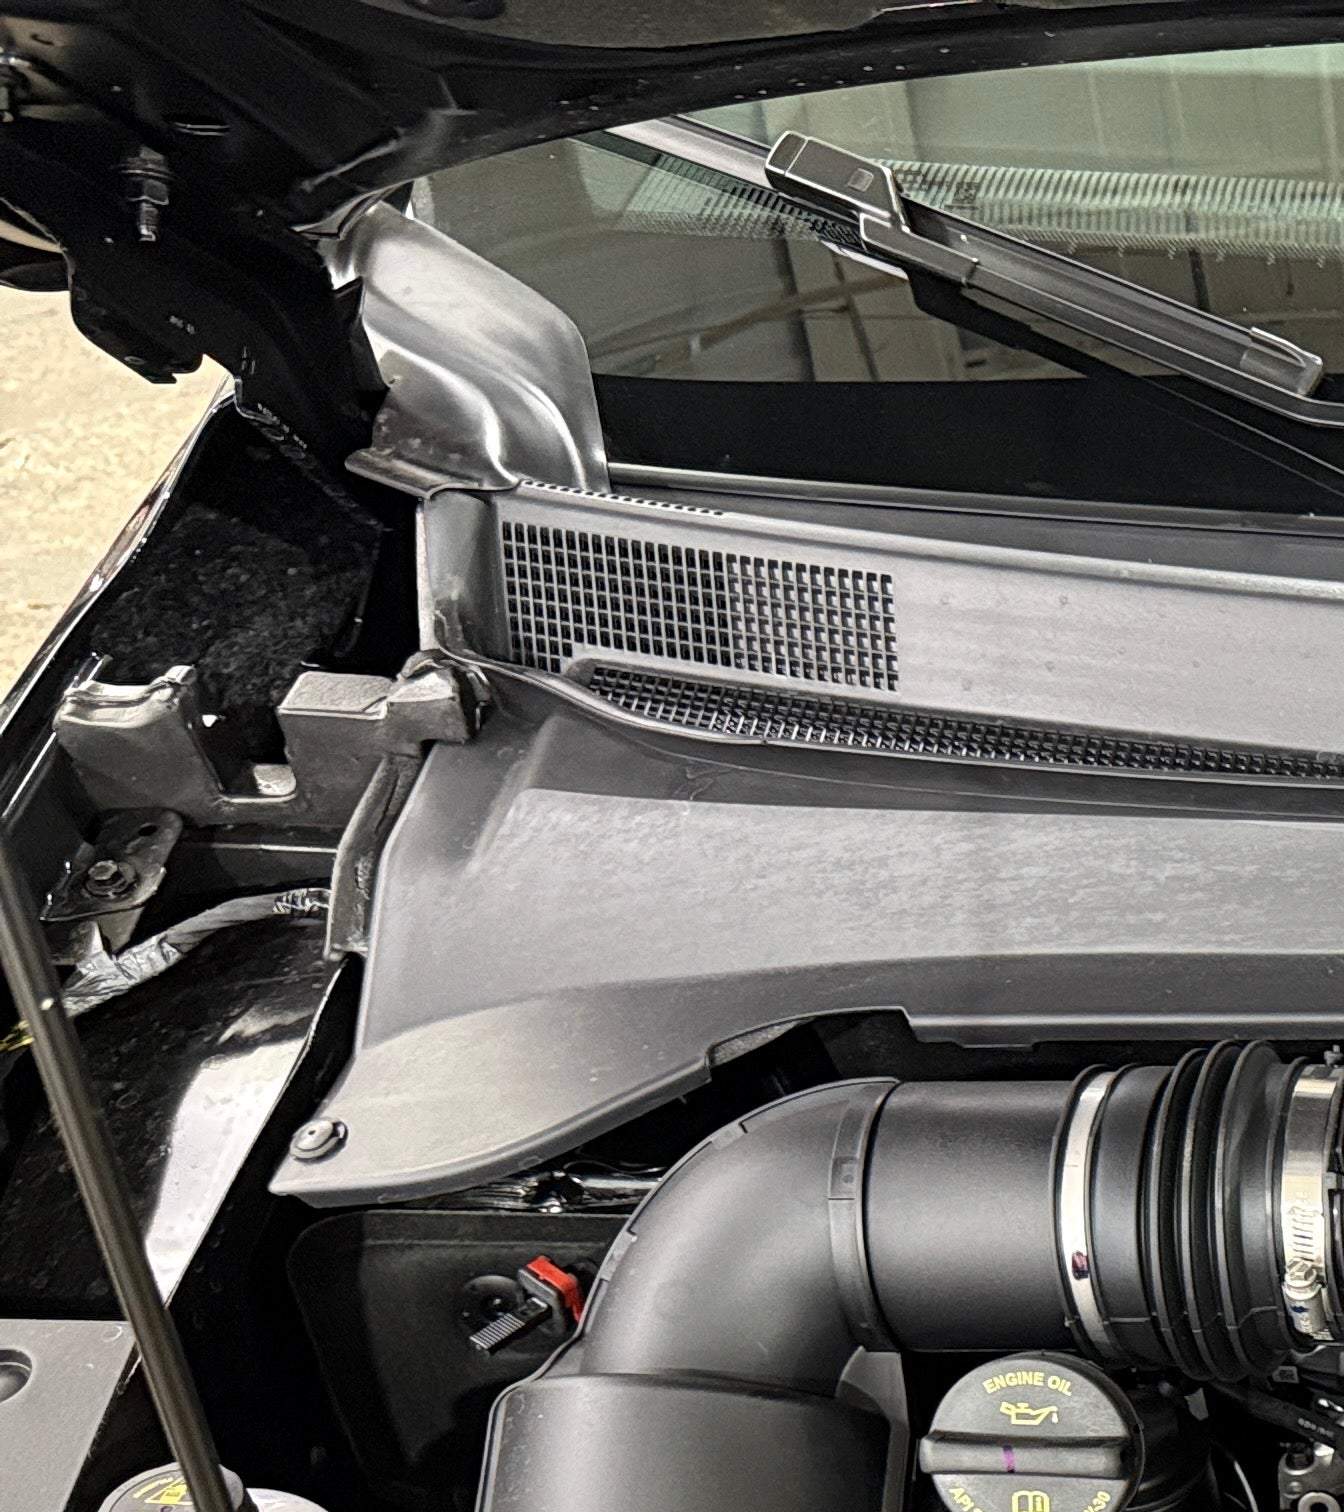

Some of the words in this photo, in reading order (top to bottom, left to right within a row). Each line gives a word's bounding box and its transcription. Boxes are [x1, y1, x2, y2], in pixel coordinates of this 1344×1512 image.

[983, 1371, 1044, 1394] ENGINE
[1047, 1375, 1073, 1396] OIL
[949, 1486, 970, 1512] API
